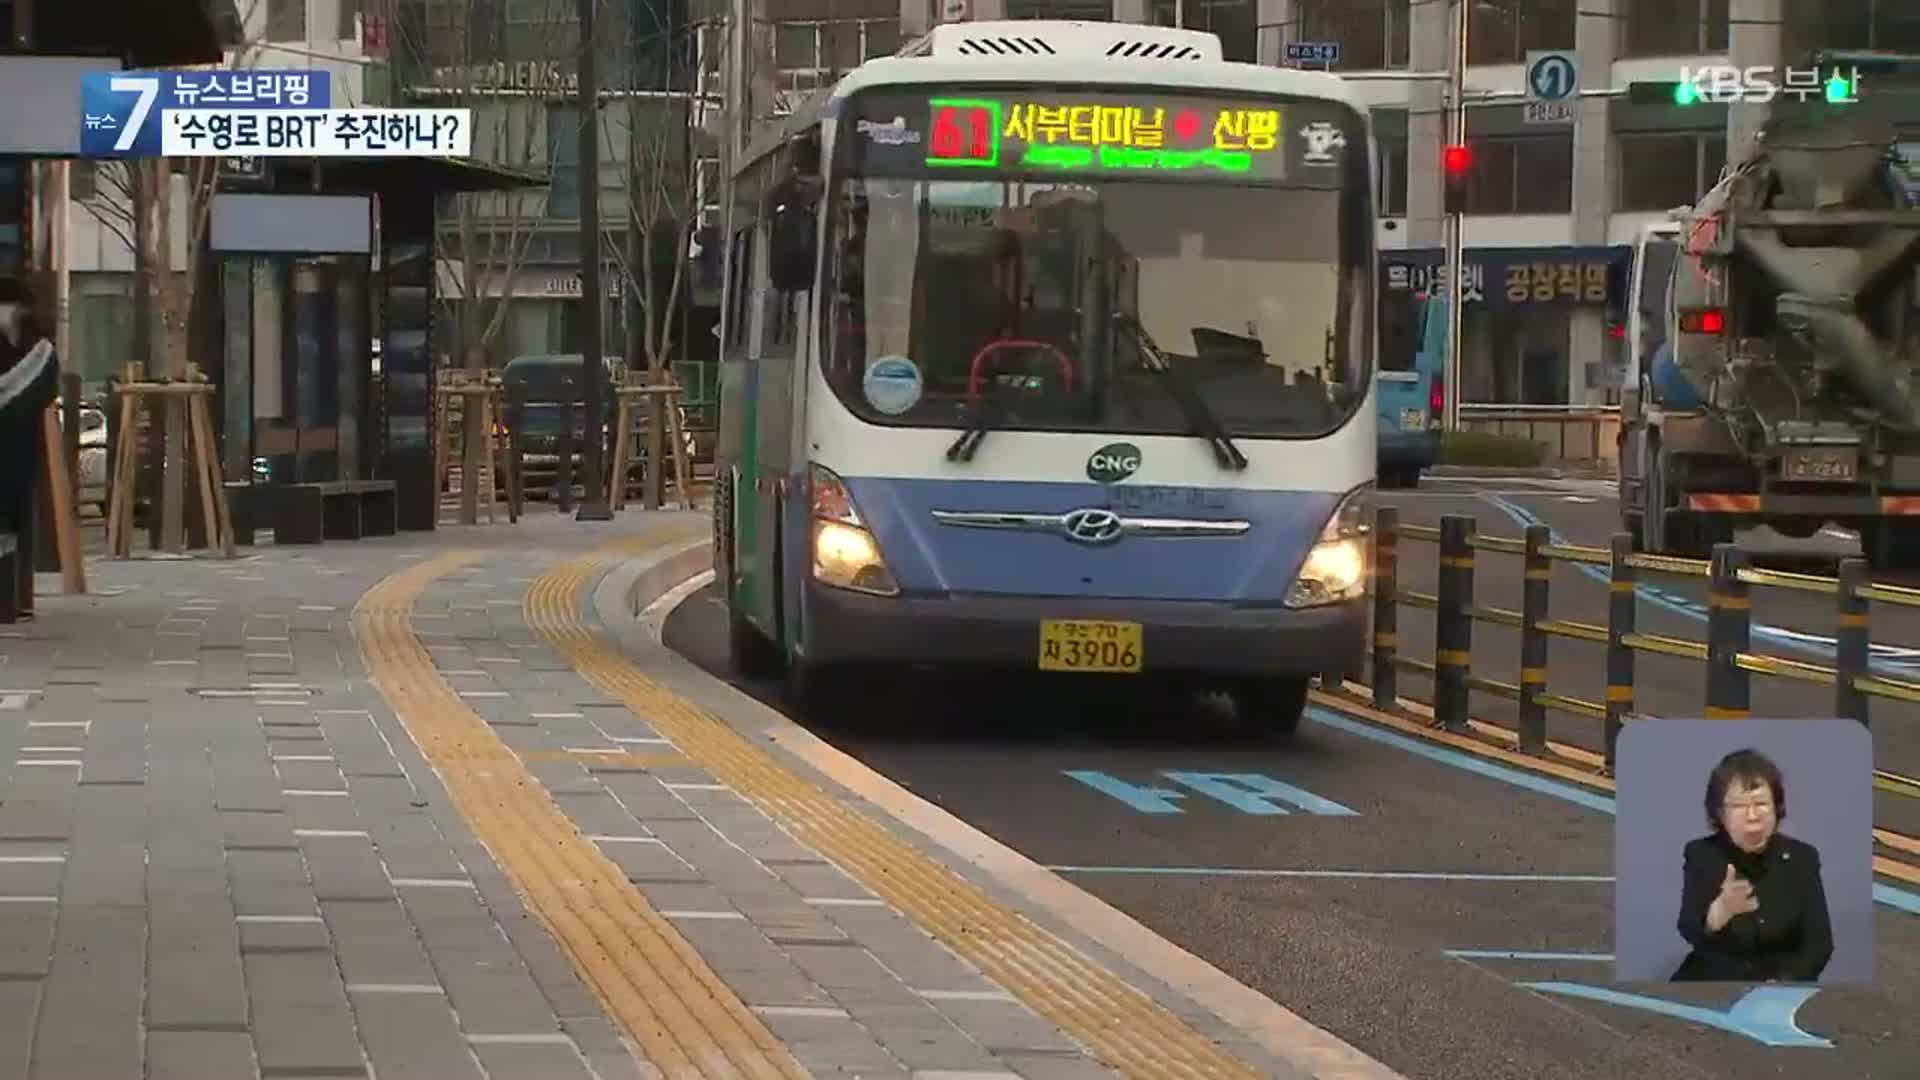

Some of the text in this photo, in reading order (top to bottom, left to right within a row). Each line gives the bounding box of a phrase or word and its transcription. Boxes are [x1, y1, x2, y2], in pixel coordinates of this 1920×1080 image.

[931, 106, 990, 157] 61
[1003, 103, 1165, 147] 서부터미널
[1213, 107, 1280, 150] 신평
[1506, 263, 1607, 301] 공장직영
[1091, 455, 1138, 473] CNG
